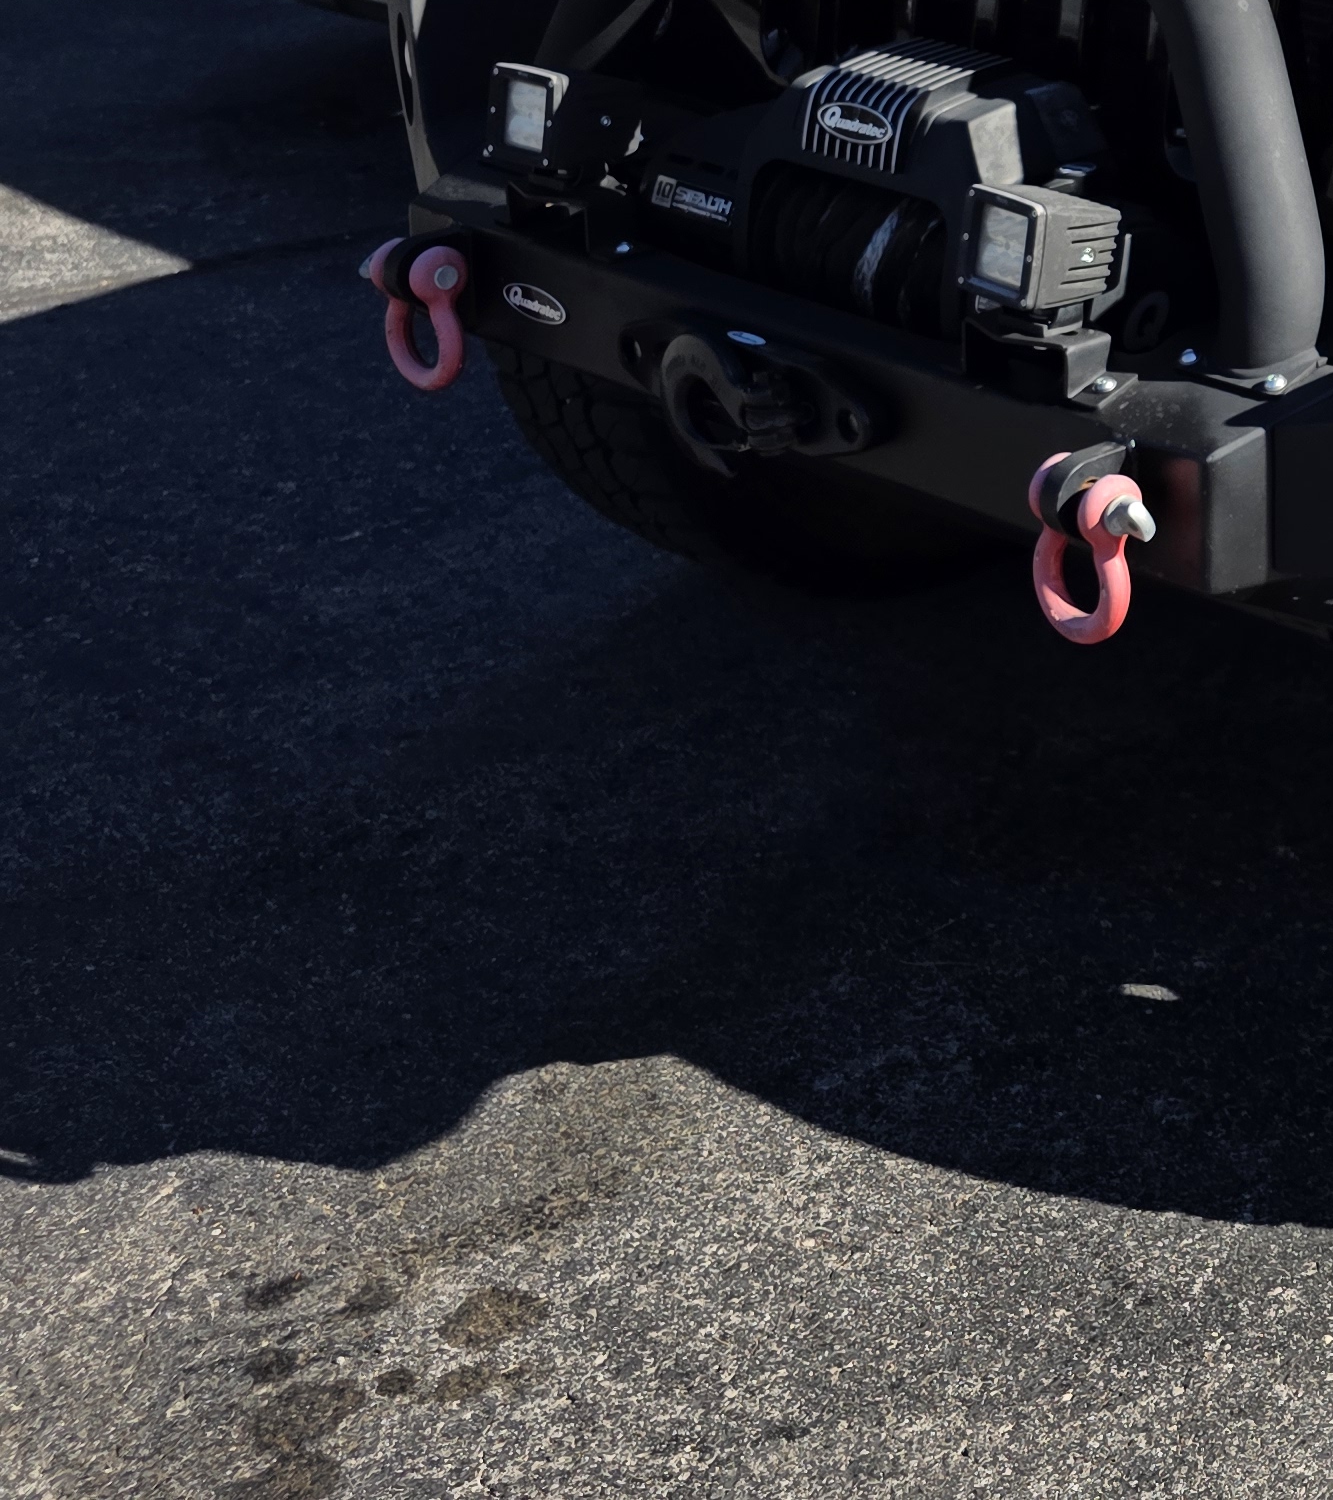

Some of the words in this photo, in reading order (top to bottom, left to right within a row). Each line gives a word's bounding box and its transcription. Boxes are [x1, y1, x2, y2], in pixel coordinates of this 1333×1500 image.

[823, 105, 886, 139] Quadratec
[674, 185, 733, 216] STEALTH
[509, 285, 562, 321] Quadratec
